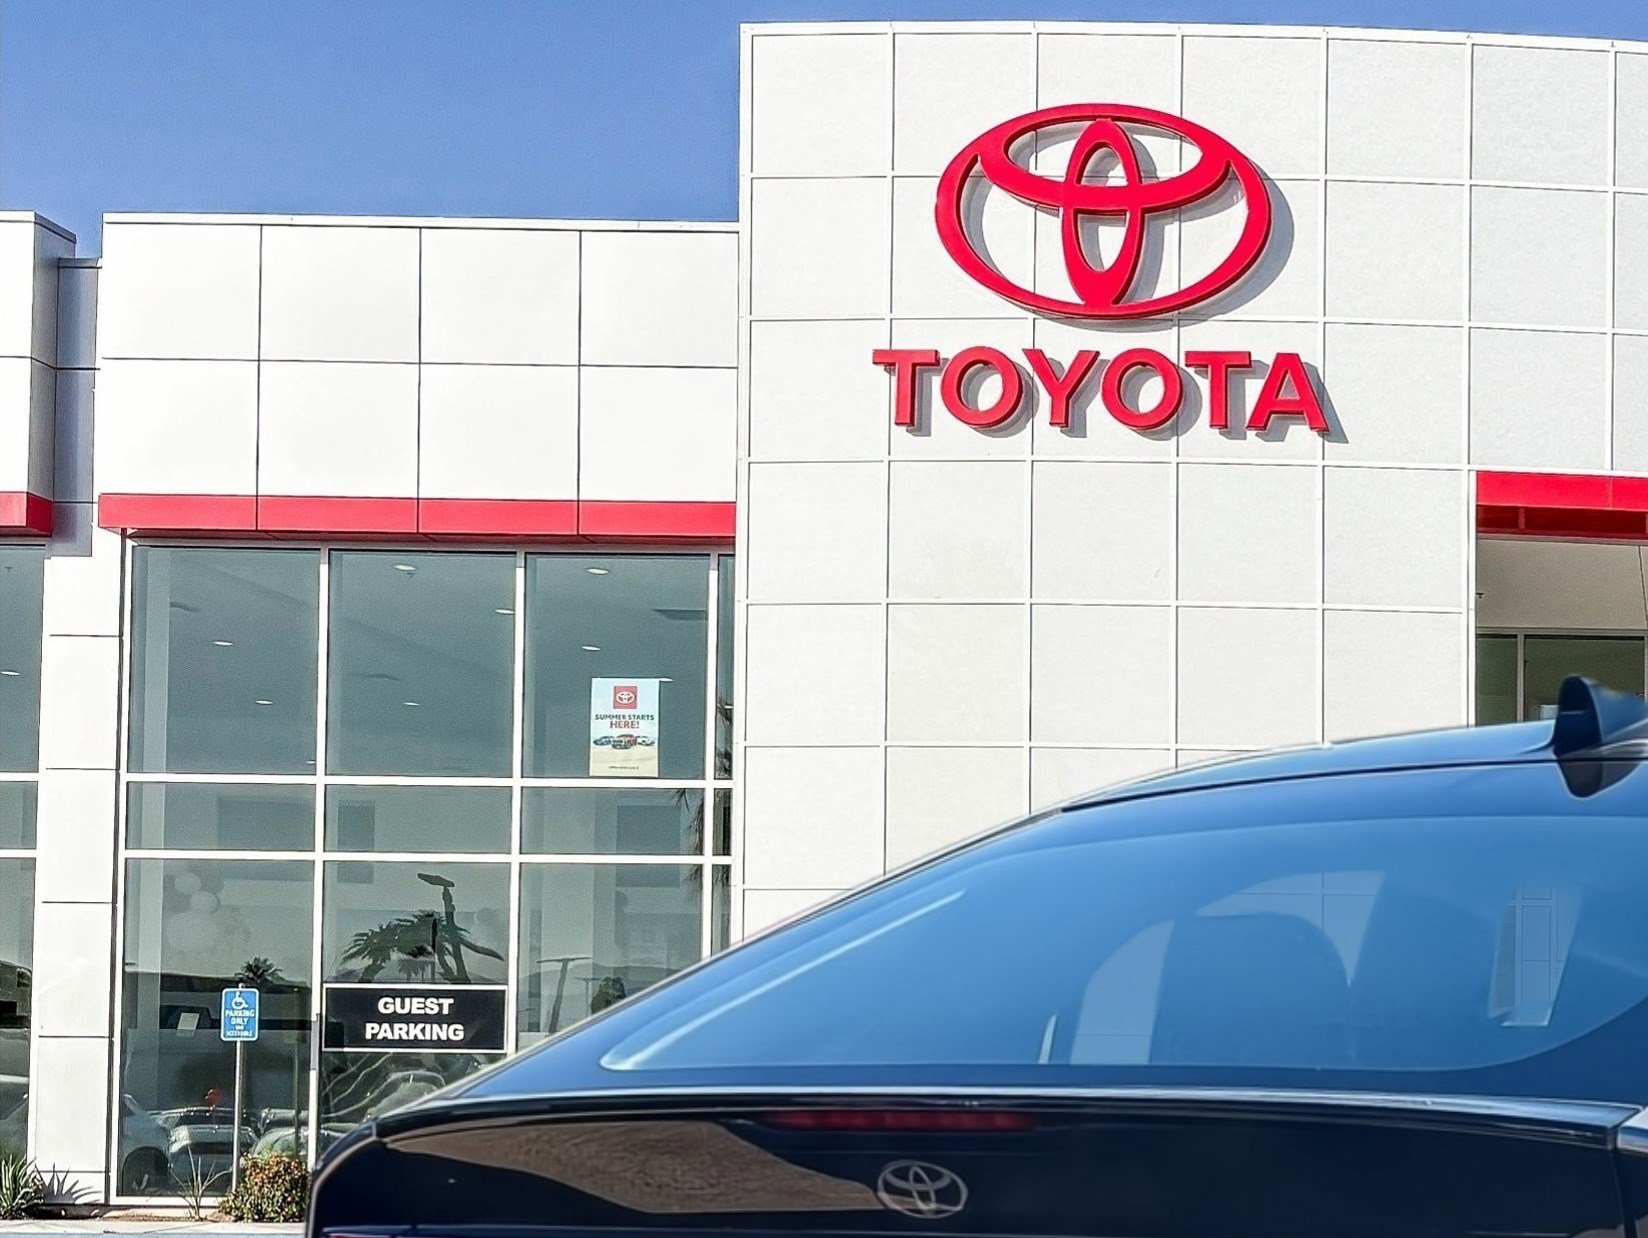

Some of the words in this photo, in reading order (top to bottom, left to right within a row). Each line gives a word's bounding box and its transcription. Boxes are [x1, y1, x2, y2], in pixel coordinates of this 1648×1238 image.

[872, 345, 1330, 433] TOYOTA
[610, 721, 640, 729] HERE!
[377, 996, 455, 1016] GUEST
[364, 1022, 465, 1042] PARKING
